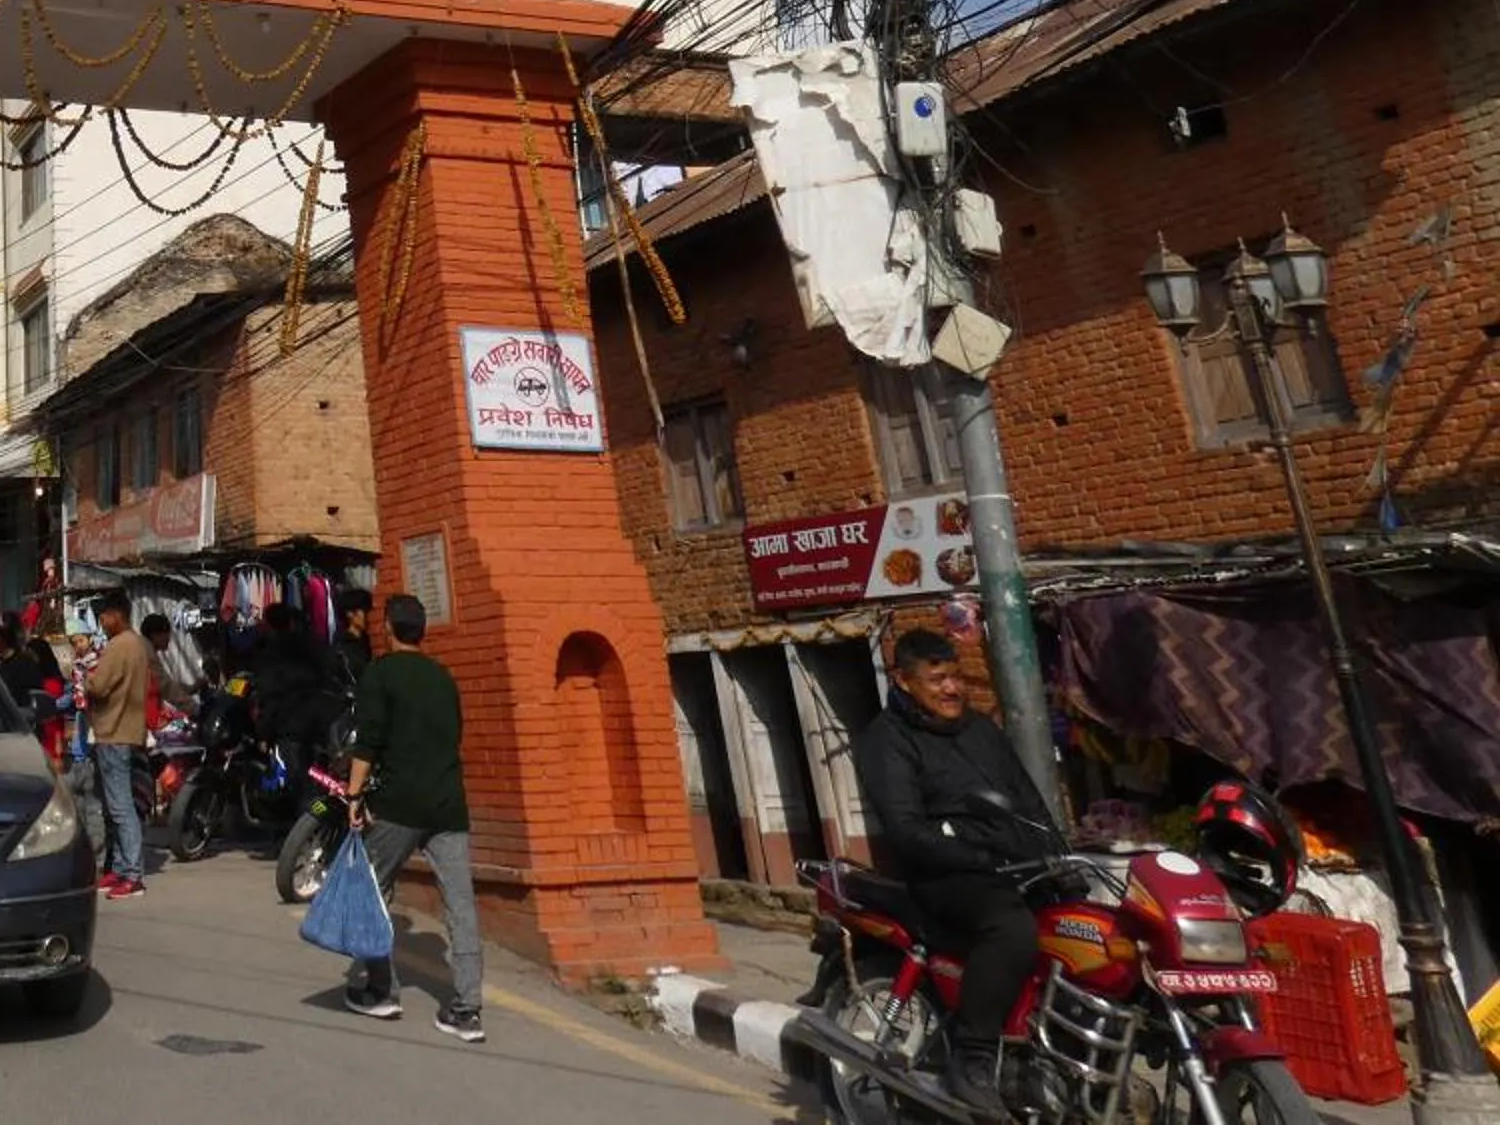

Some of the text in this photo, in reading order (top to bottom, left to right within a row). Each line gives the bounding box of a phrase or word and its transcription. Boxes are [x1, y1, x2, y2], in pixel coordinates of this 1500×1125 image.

[470, 358, 495, 386] चार
[477, 403, 594, 430] प्रवेश निषेध
[748, 520, 870, 559] आमा खाजा घर
